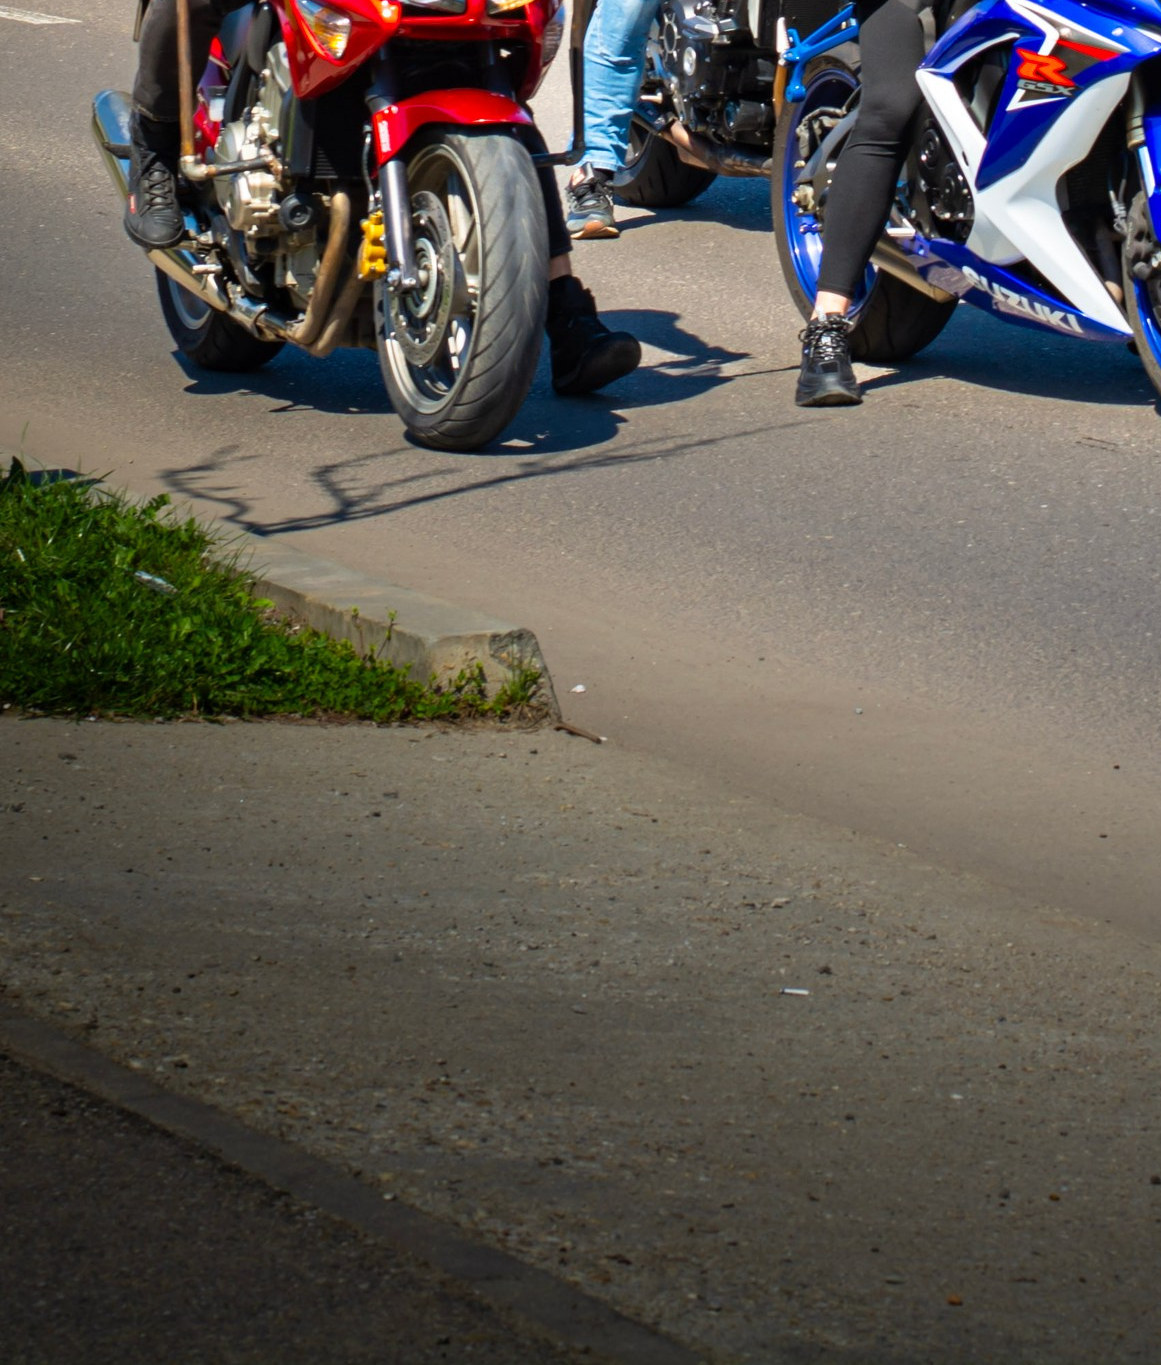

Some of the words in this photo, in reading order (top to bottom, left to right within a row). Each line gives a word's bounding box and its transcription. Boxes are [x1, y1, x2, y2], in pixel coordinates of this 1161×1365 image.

[1016, 47, 1075, 88] R
[1017, 78, 1075, 96] GSX
[962, 265, 1084, 334] SUZUKI
